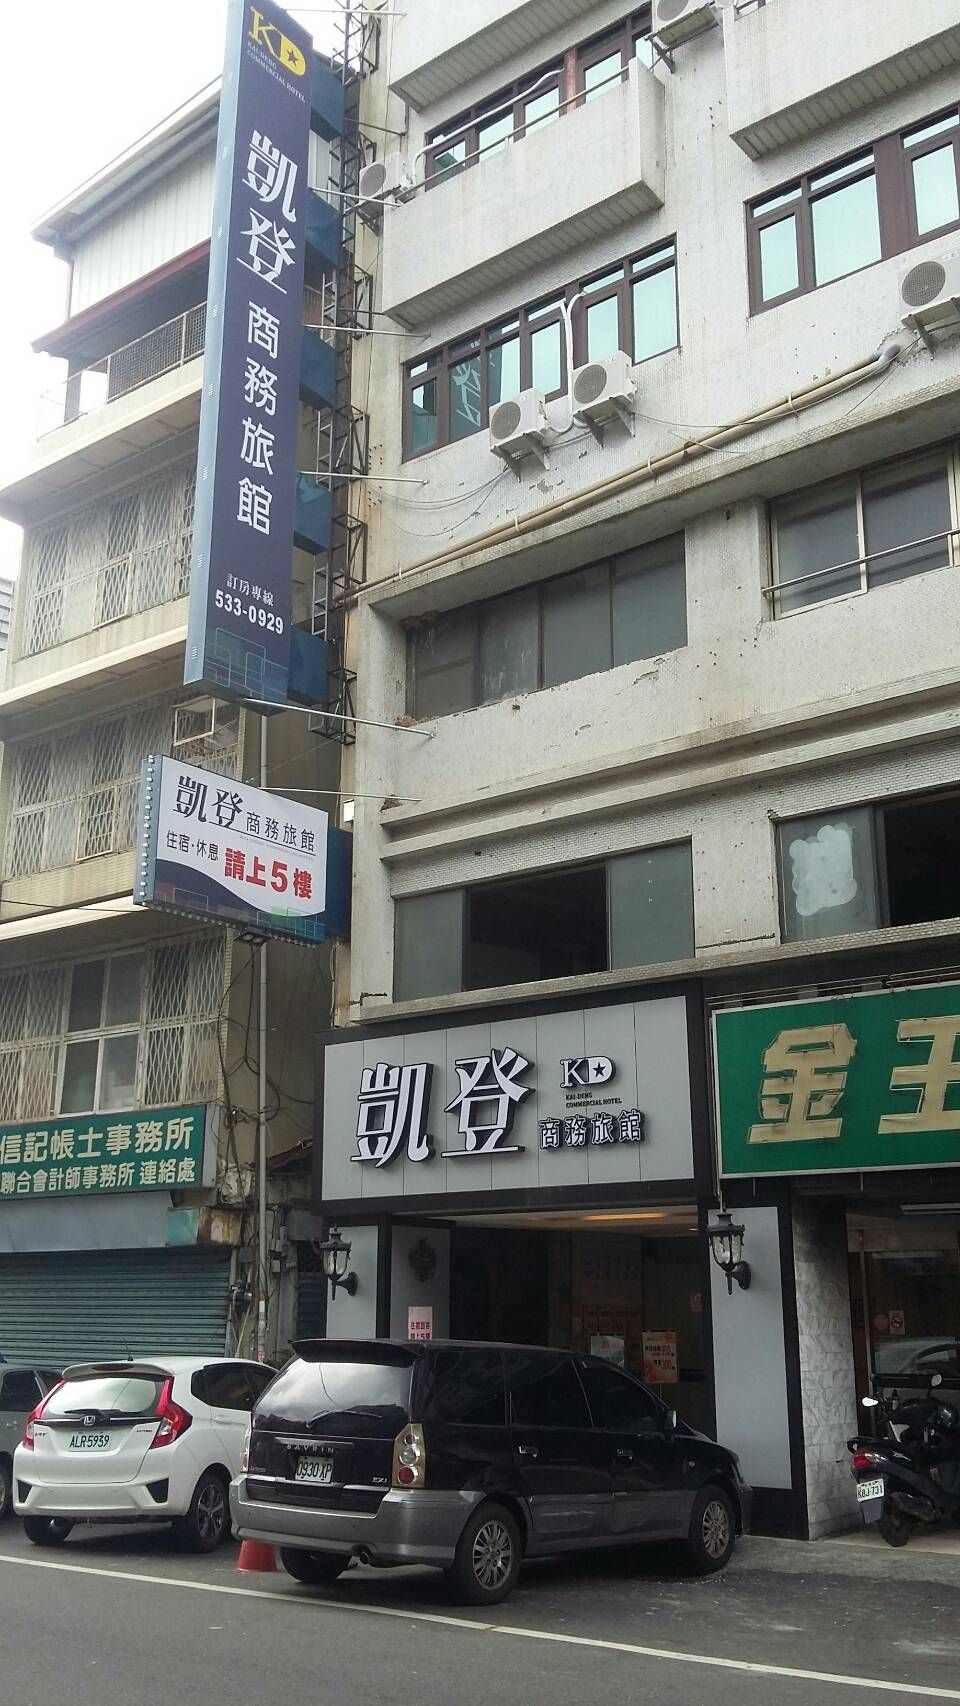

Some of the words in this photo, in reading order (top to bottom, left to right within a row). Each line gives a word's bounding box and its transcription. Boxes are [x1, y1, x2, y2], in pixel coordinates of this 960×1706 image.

[248, 6, 306, 76] KD
[286, 82, 306, 104] HOTEL
[226, 573, 274, 607] 訂房專線
[215, 589, 284, 635] 533-0929
[224, 847, 313, 900] 請上5樓
[560, 1055, 616, 1089] KD
[350, 1046, 533, 1168] 凱登
[565, 1092, 593, 1101] KAI-DENG
[565, 1099, 602, 1109] COMMERCIAL
[602, 1097, 623, 1106] HOTEL
[0, 1116, 195, 1165] 信記帳士事務所
[538, 1109, 645, 1150] 商務旅館
[0, 1162, 135, 1195] 聯合會計師事務所
[139, 1157, 196, 1185] 連絡處
